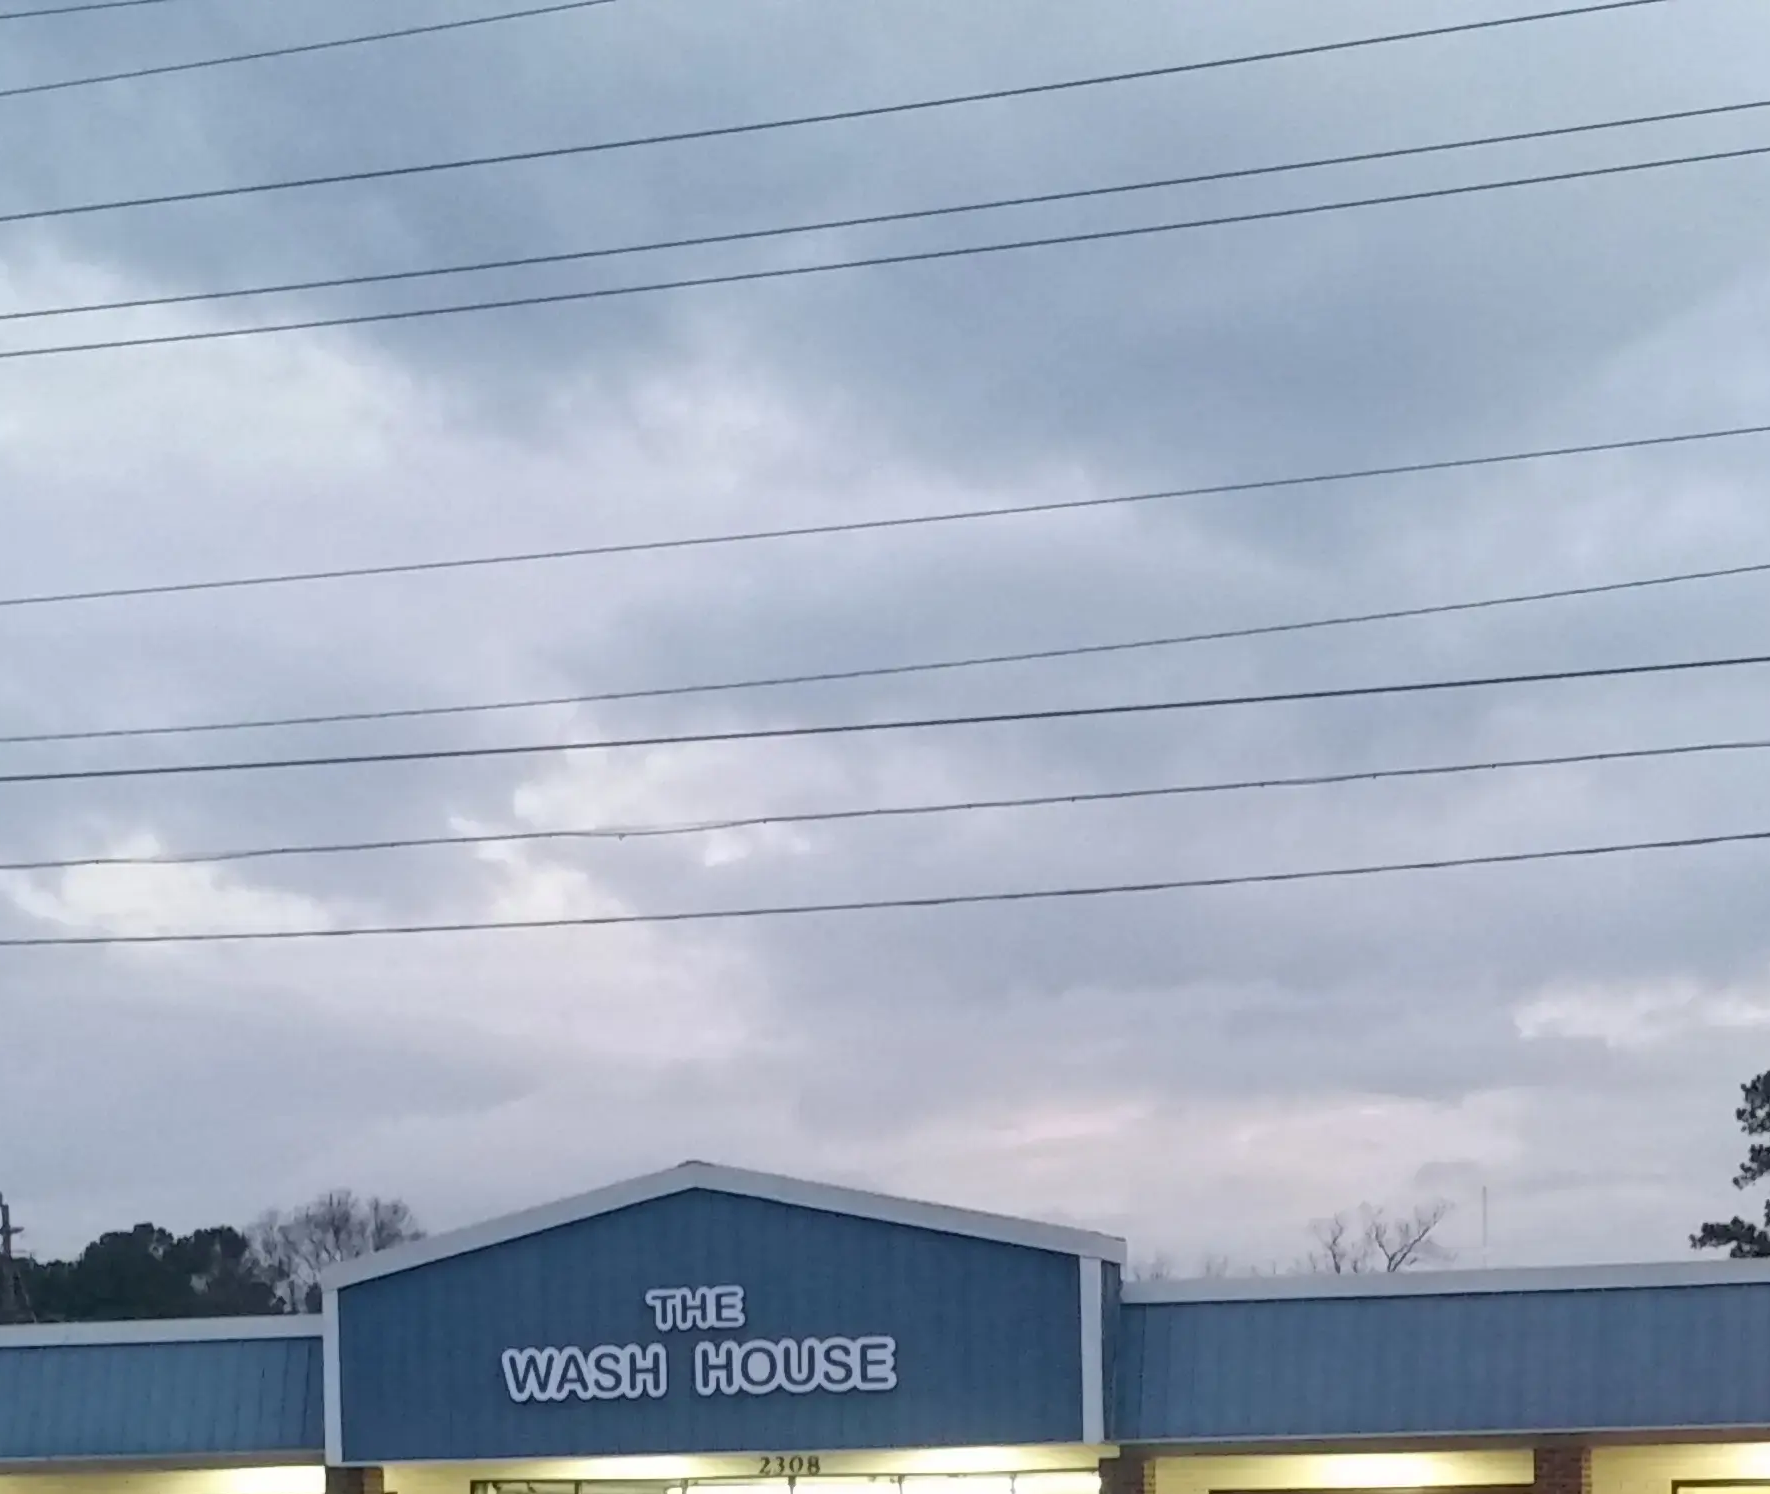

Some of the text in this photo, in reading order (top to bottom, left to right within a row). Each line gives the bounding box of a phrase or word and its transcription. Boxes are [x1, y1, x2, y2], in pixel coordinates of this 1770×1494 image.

[646, 1285, 746, 1332] THE
[502, 1336, 897, 1402] WASH HOUSE
[759, 1455, 820, 1476] 2308
